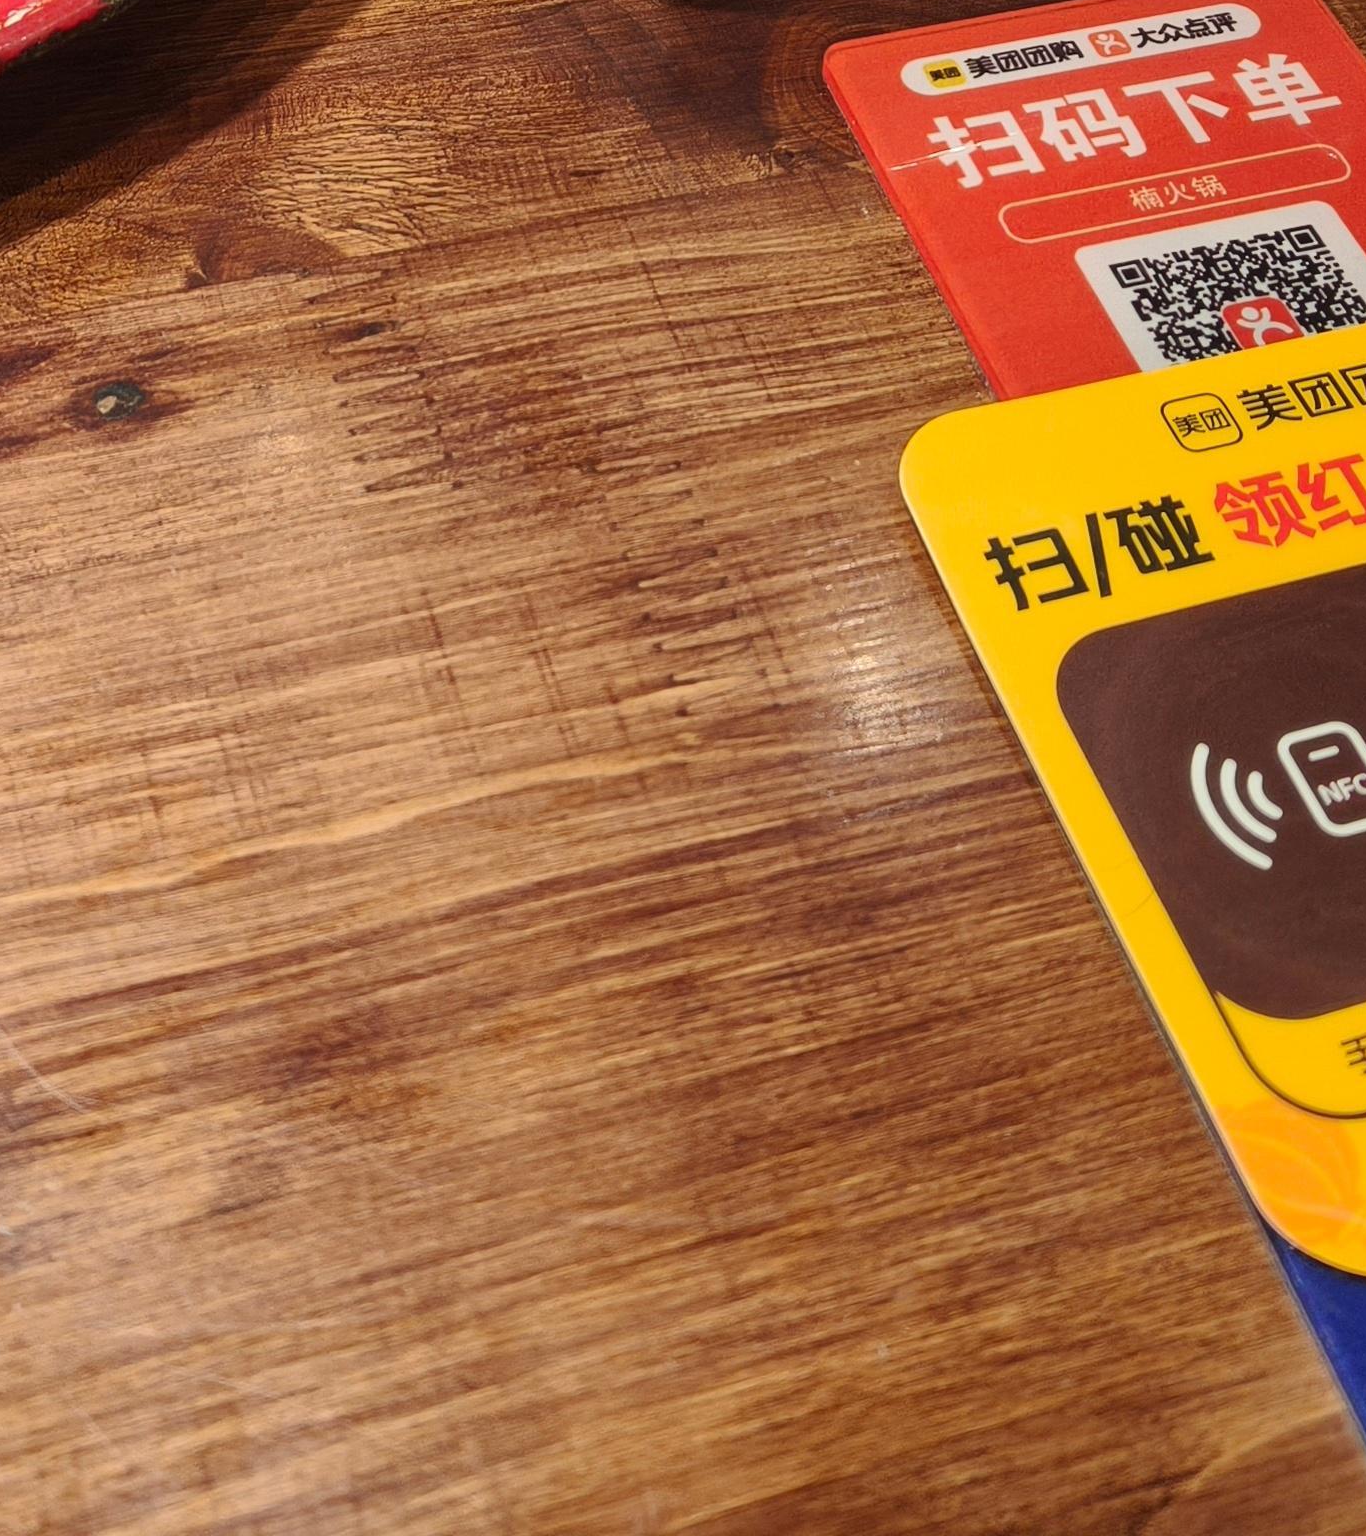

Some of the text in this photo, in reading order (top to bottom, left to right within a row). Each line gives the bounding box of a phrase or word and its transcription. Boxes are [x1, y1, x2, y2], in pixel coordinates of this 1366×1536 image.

[963, 39, 1085, 79] 美团团购
[1131, 11, 1238, 49] 大众点评
[927, 52, 1342, 190] 扫码下单
[1128, 174, 1228, 212] 楠火锅
[1172, 407, 1234, 439] 美团
[983, 494, 1216, 612] 扫/碰
